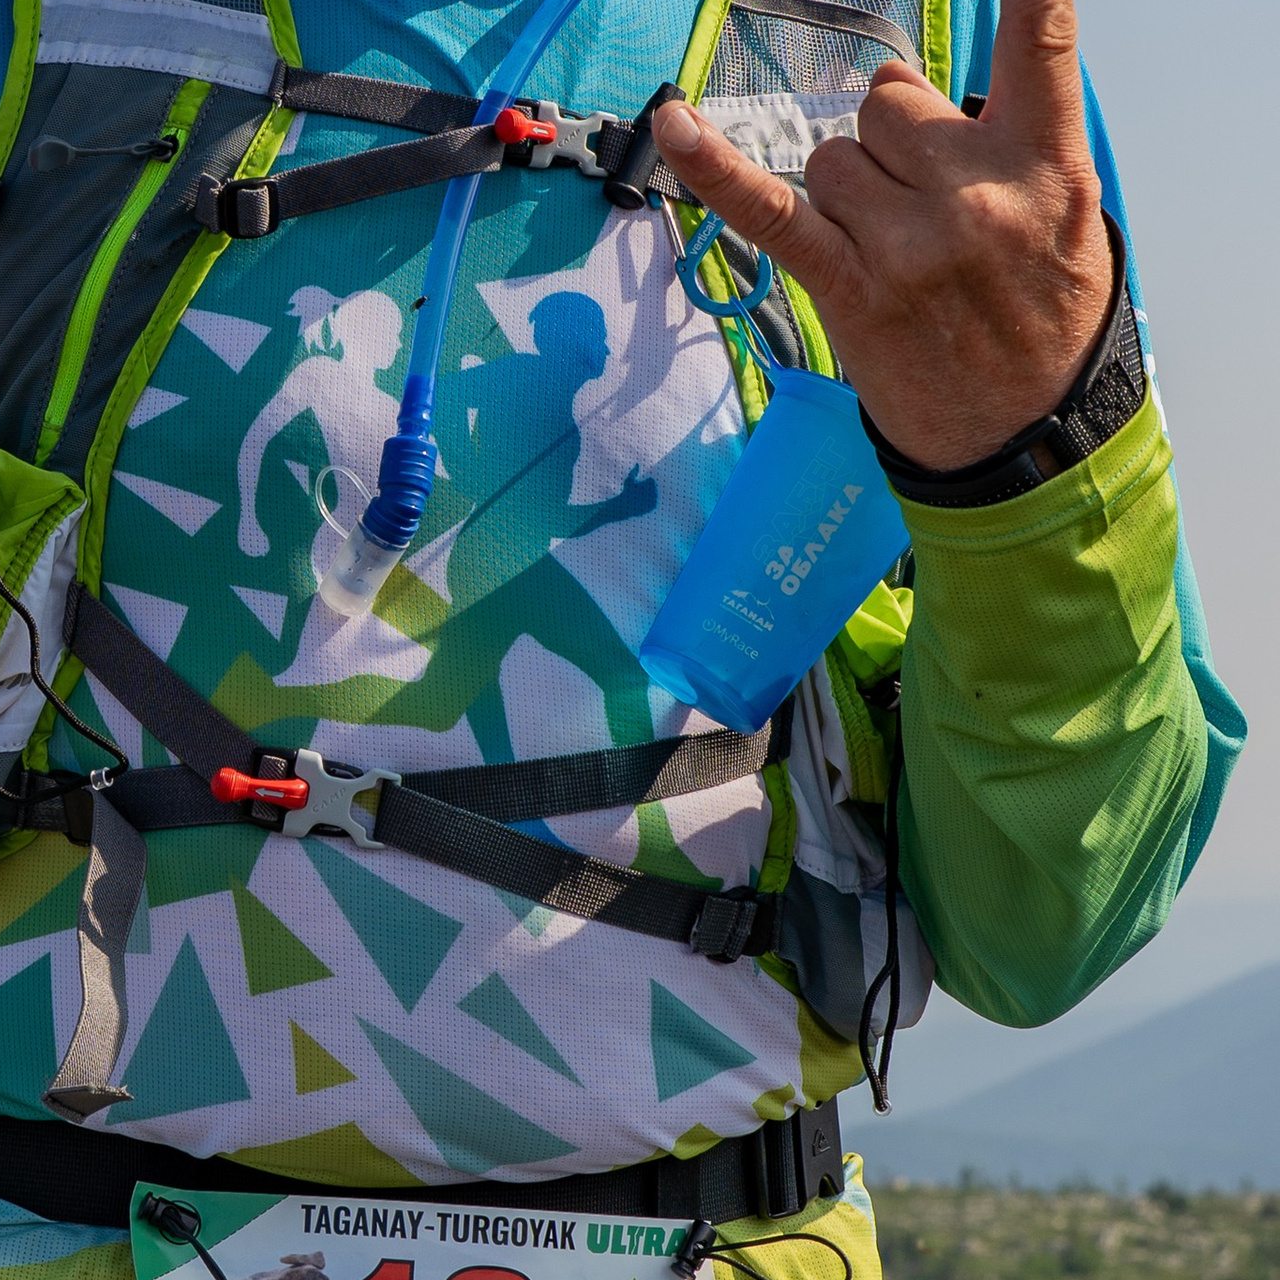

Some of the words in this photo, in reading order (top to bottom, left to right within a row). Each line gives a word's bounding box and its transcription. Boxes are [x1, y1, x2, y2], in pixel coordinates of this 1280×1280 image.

[780, 484, 864, 596] ОБЛАКА
[765, 546, 794, 580] ЗА
[713, 624, 759, 660] MyRace
[301, 1204, 576, 1251] TAGANAY-TURGOYAK
[586, 1223, 688, 1257] ULTRA
